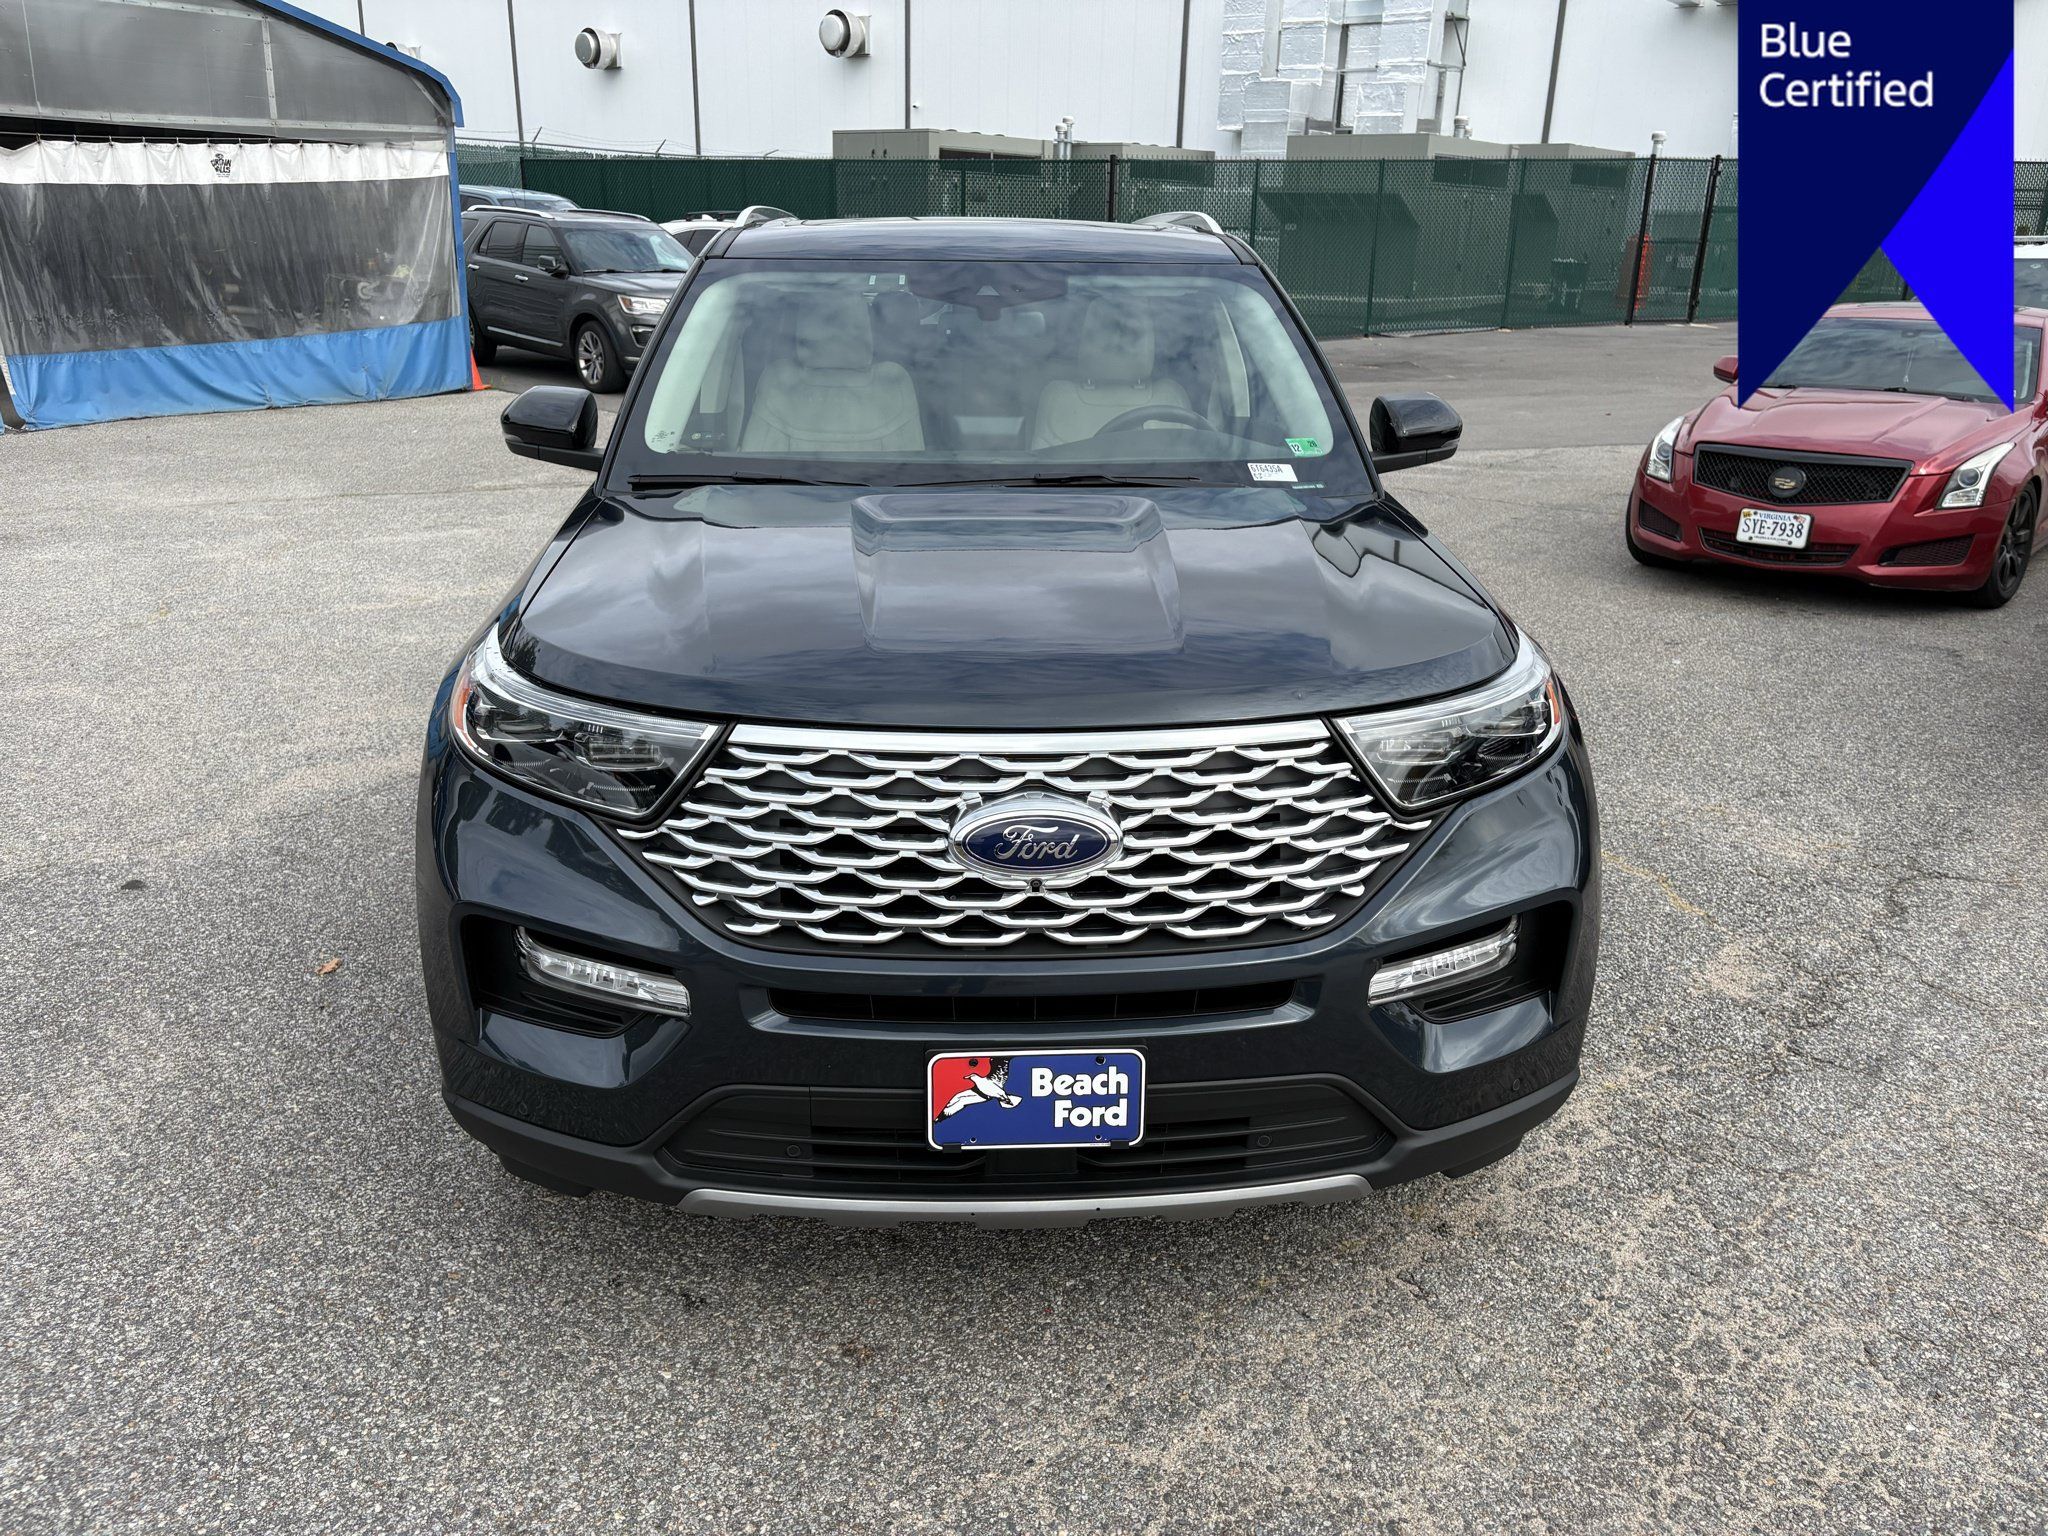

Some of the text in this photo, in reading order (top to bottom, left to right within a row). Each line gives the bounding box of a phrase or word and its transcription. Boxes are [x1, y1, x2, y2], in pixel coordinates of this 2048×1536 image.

[1291, 444, 1302, 452] 12
[1742, 518, 1804, 539] SYE-7938
[1759, 512, 1792, 522] VIRGINIA
[994, 824, 1081, 861] Ford
[1031, 1066, 1129, 1097] Beach
[1054, 1098, 1128, 1128] Ford
